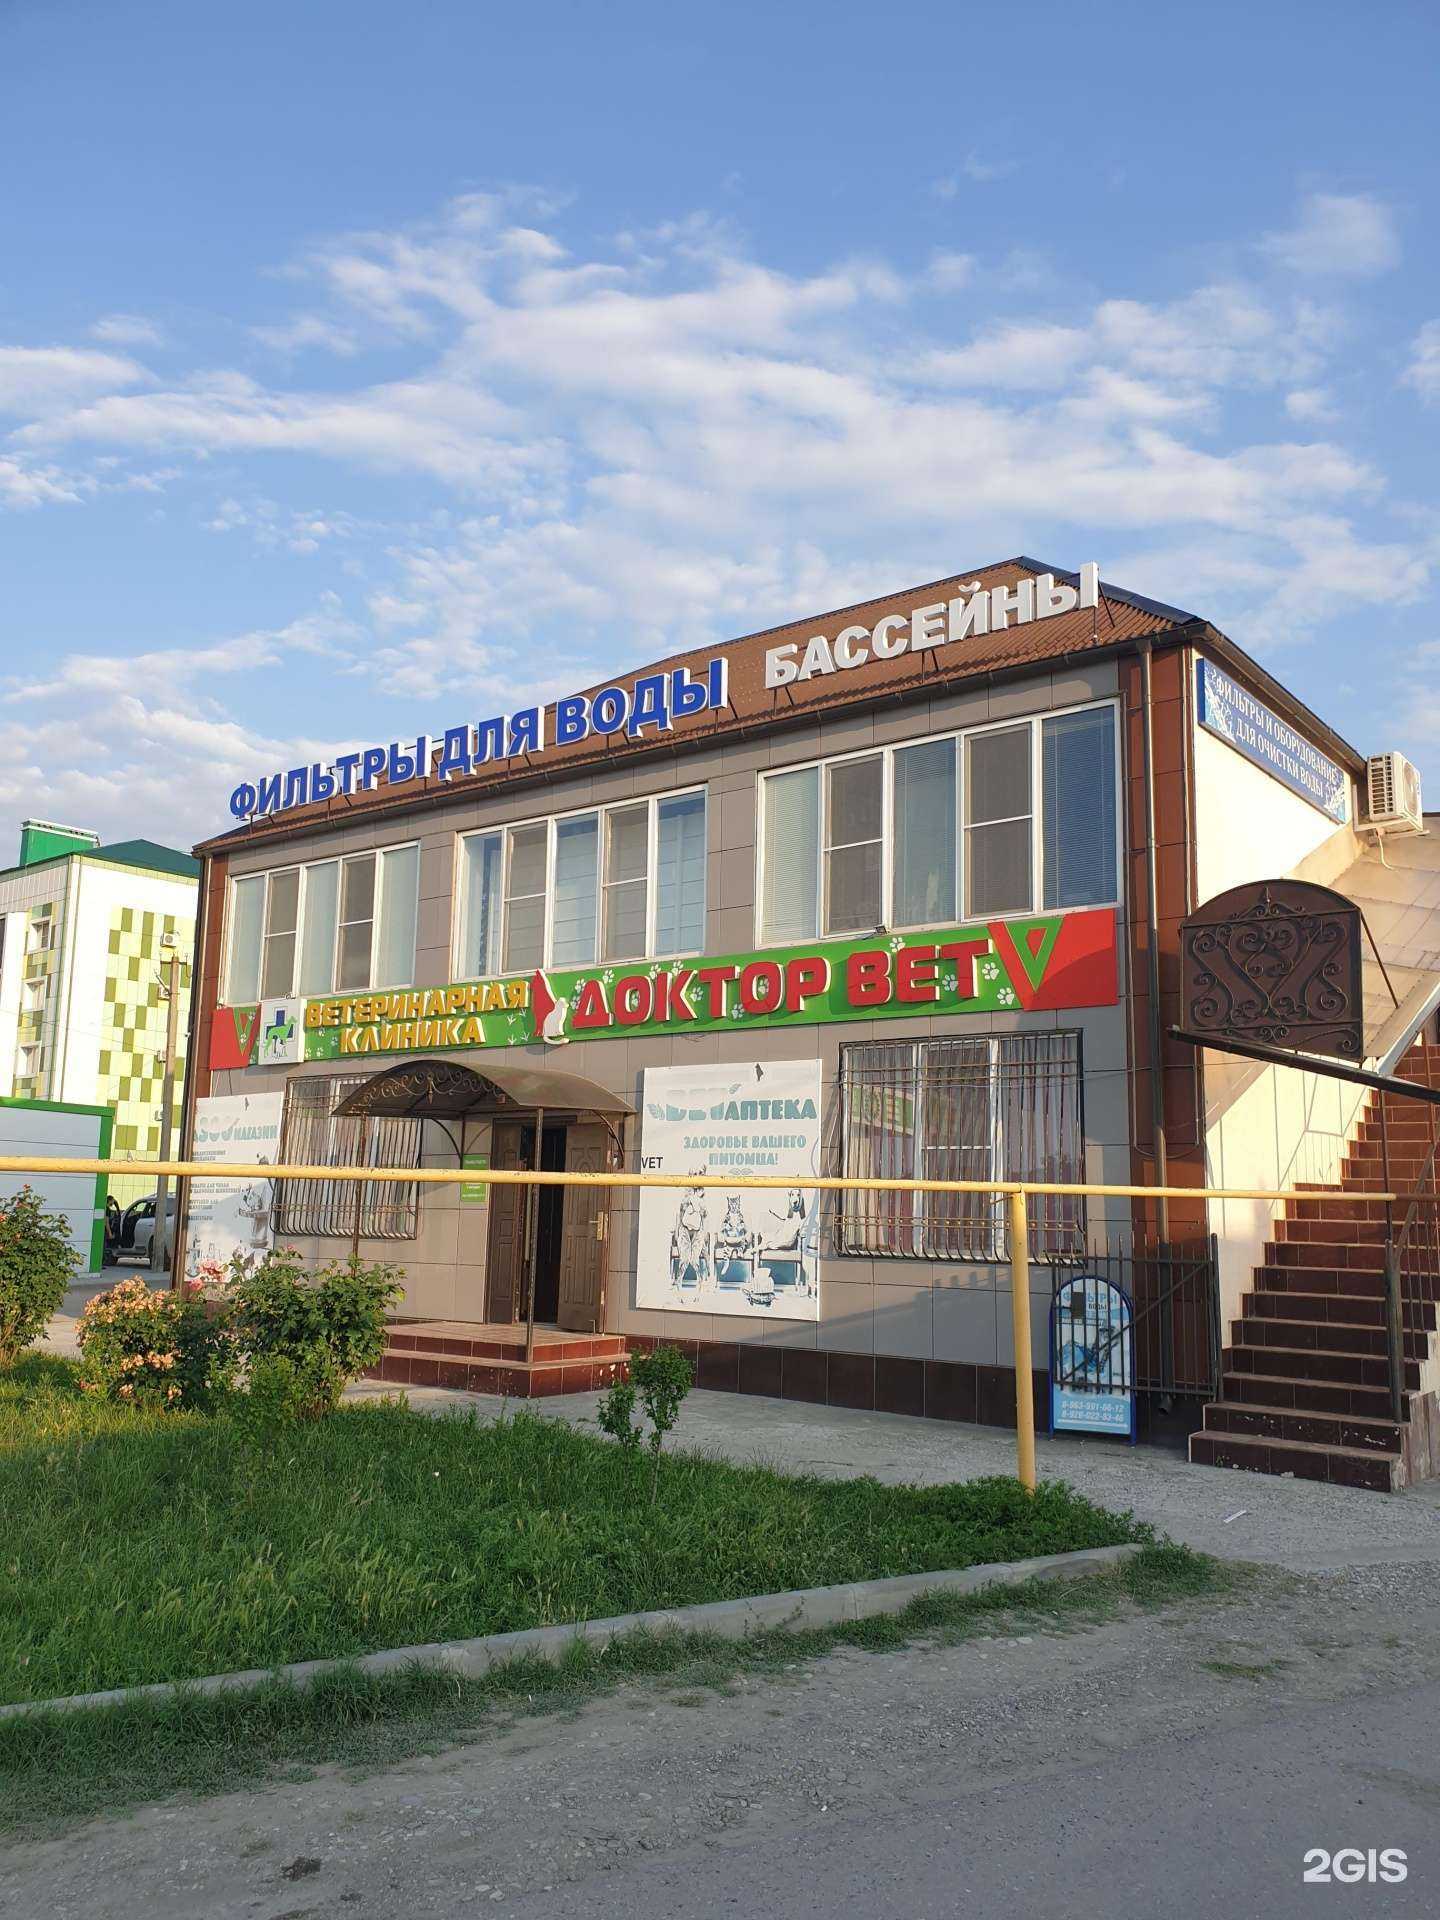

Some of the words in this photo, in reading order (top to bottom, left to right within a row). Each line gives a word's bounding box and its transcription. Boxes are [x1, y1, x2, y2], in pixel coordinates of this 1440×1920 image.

[765, 562, 1099, 690] БАССЕЙНЫ
[229, 734, 432, 820] ФИЛЬТРЫ
[438, 706, 545, 782] ДЛЯ
[555, 657, 729, 746] ВОДЫ
[1216, 675, 1264, 730] ФИЛЬТРЫ
[1266, 716, 1273, 737] И
[1274, 722, 1338, 784] ОБОРУДОВАНИЕ
[1236, 718, 1256, 748] ДЛЯ
[1257, 735, 1299, 780] ОЧИСТКИ
[1300, 766, 1324, 798] ВОДЫ
[305, 980, 530, 1028] ВЕТЕРИНАРНАЯ
[572, 957, 832, 1029] ДОКТОР
[847, 938, 993, 1007] ВЕТ
[340, 1016, 487, 1054] КЛИНИКА
[641, 1156, 664, 1169] VET
[683, 1135, 749, 1149] ЗДОРОВЬЕ
[751, 1134, 807, 1149] ВАШЕГО
[708, 1152, 778, 1166] ПИТОМЦА!
